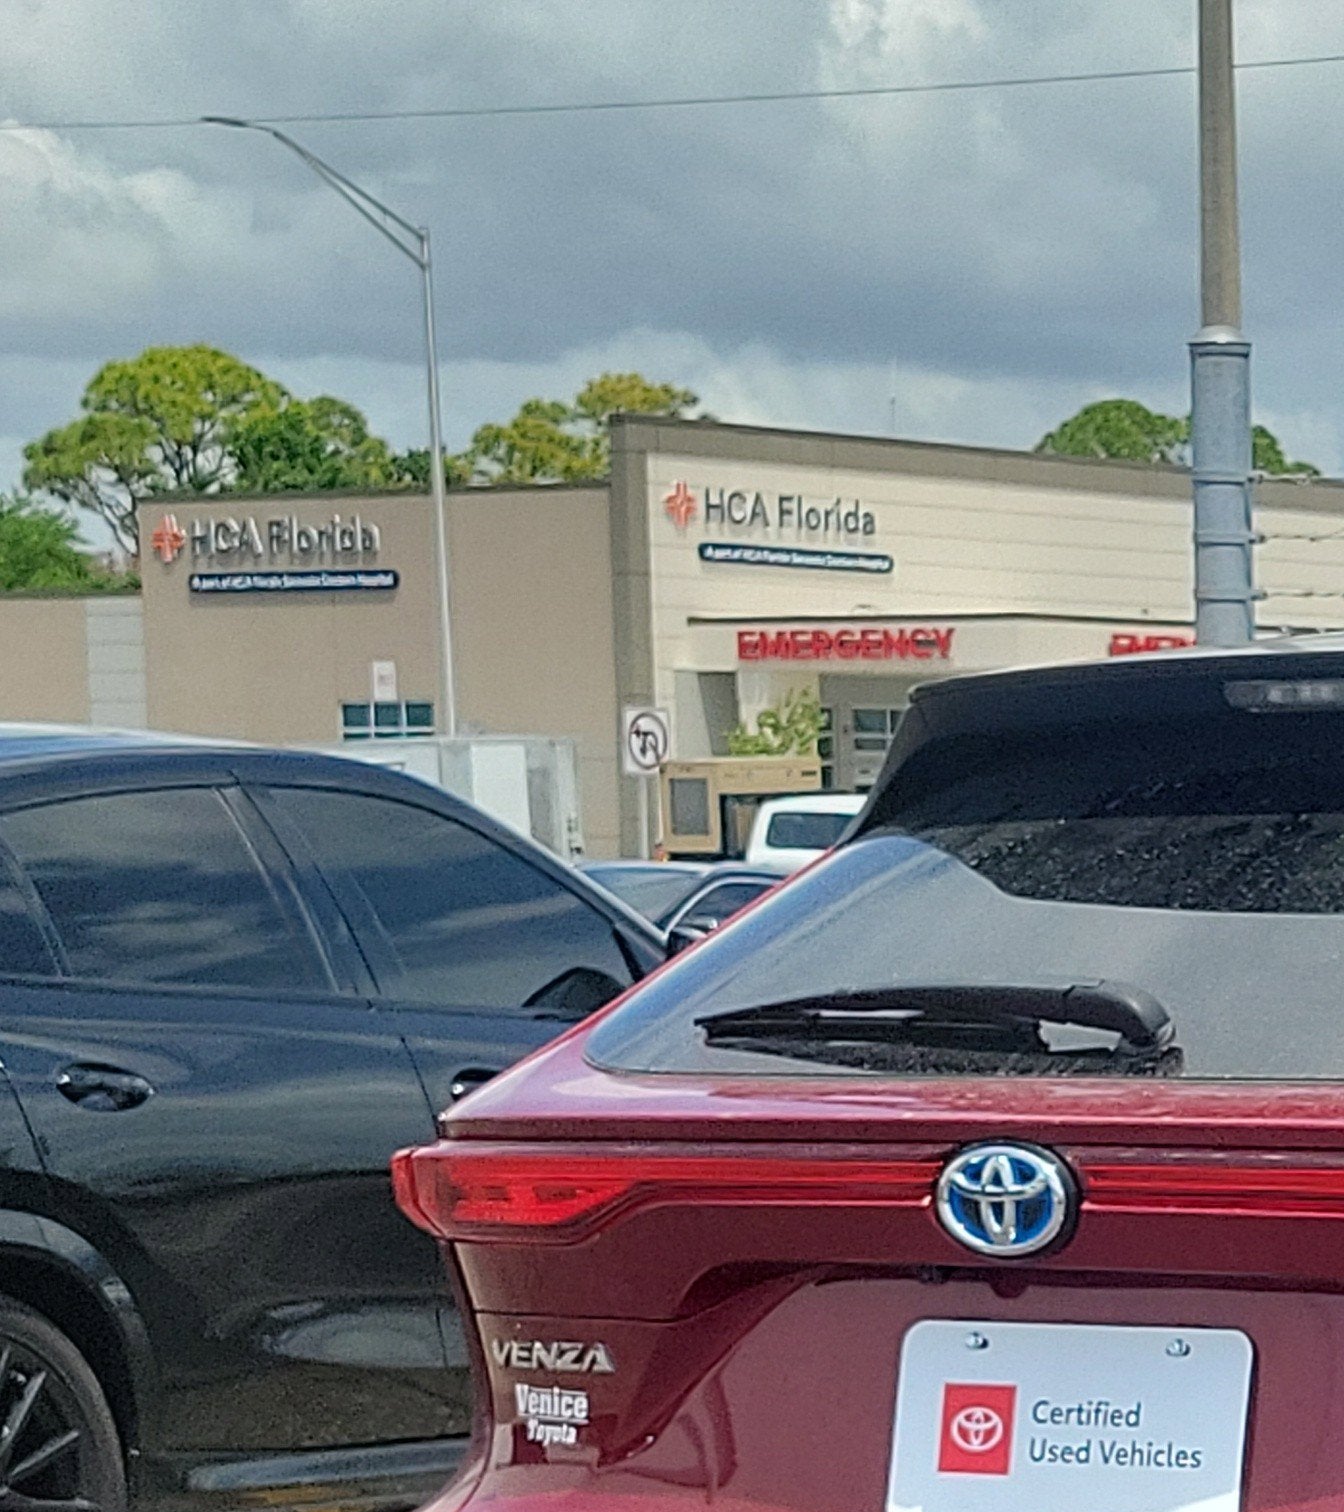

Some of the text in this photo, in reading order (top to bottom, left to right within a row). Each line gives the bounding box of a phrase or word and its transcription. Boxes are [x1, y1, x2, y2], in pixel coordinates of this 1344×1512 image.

[704, 487, 876, 536] HCA Florida
[191, 516, 263, 557] HCA
[737, 627, 956, 661] EMERGENCY
[491, 1339, 616, 1373] VENZA
[514, 1383, 589, 1419] Venice
[1032, 1400, 1142, 1428] Certified
[526, 1419, 578, 1446] Toyota
[1029, 1438, 1202, 1469] Used Vehicles
